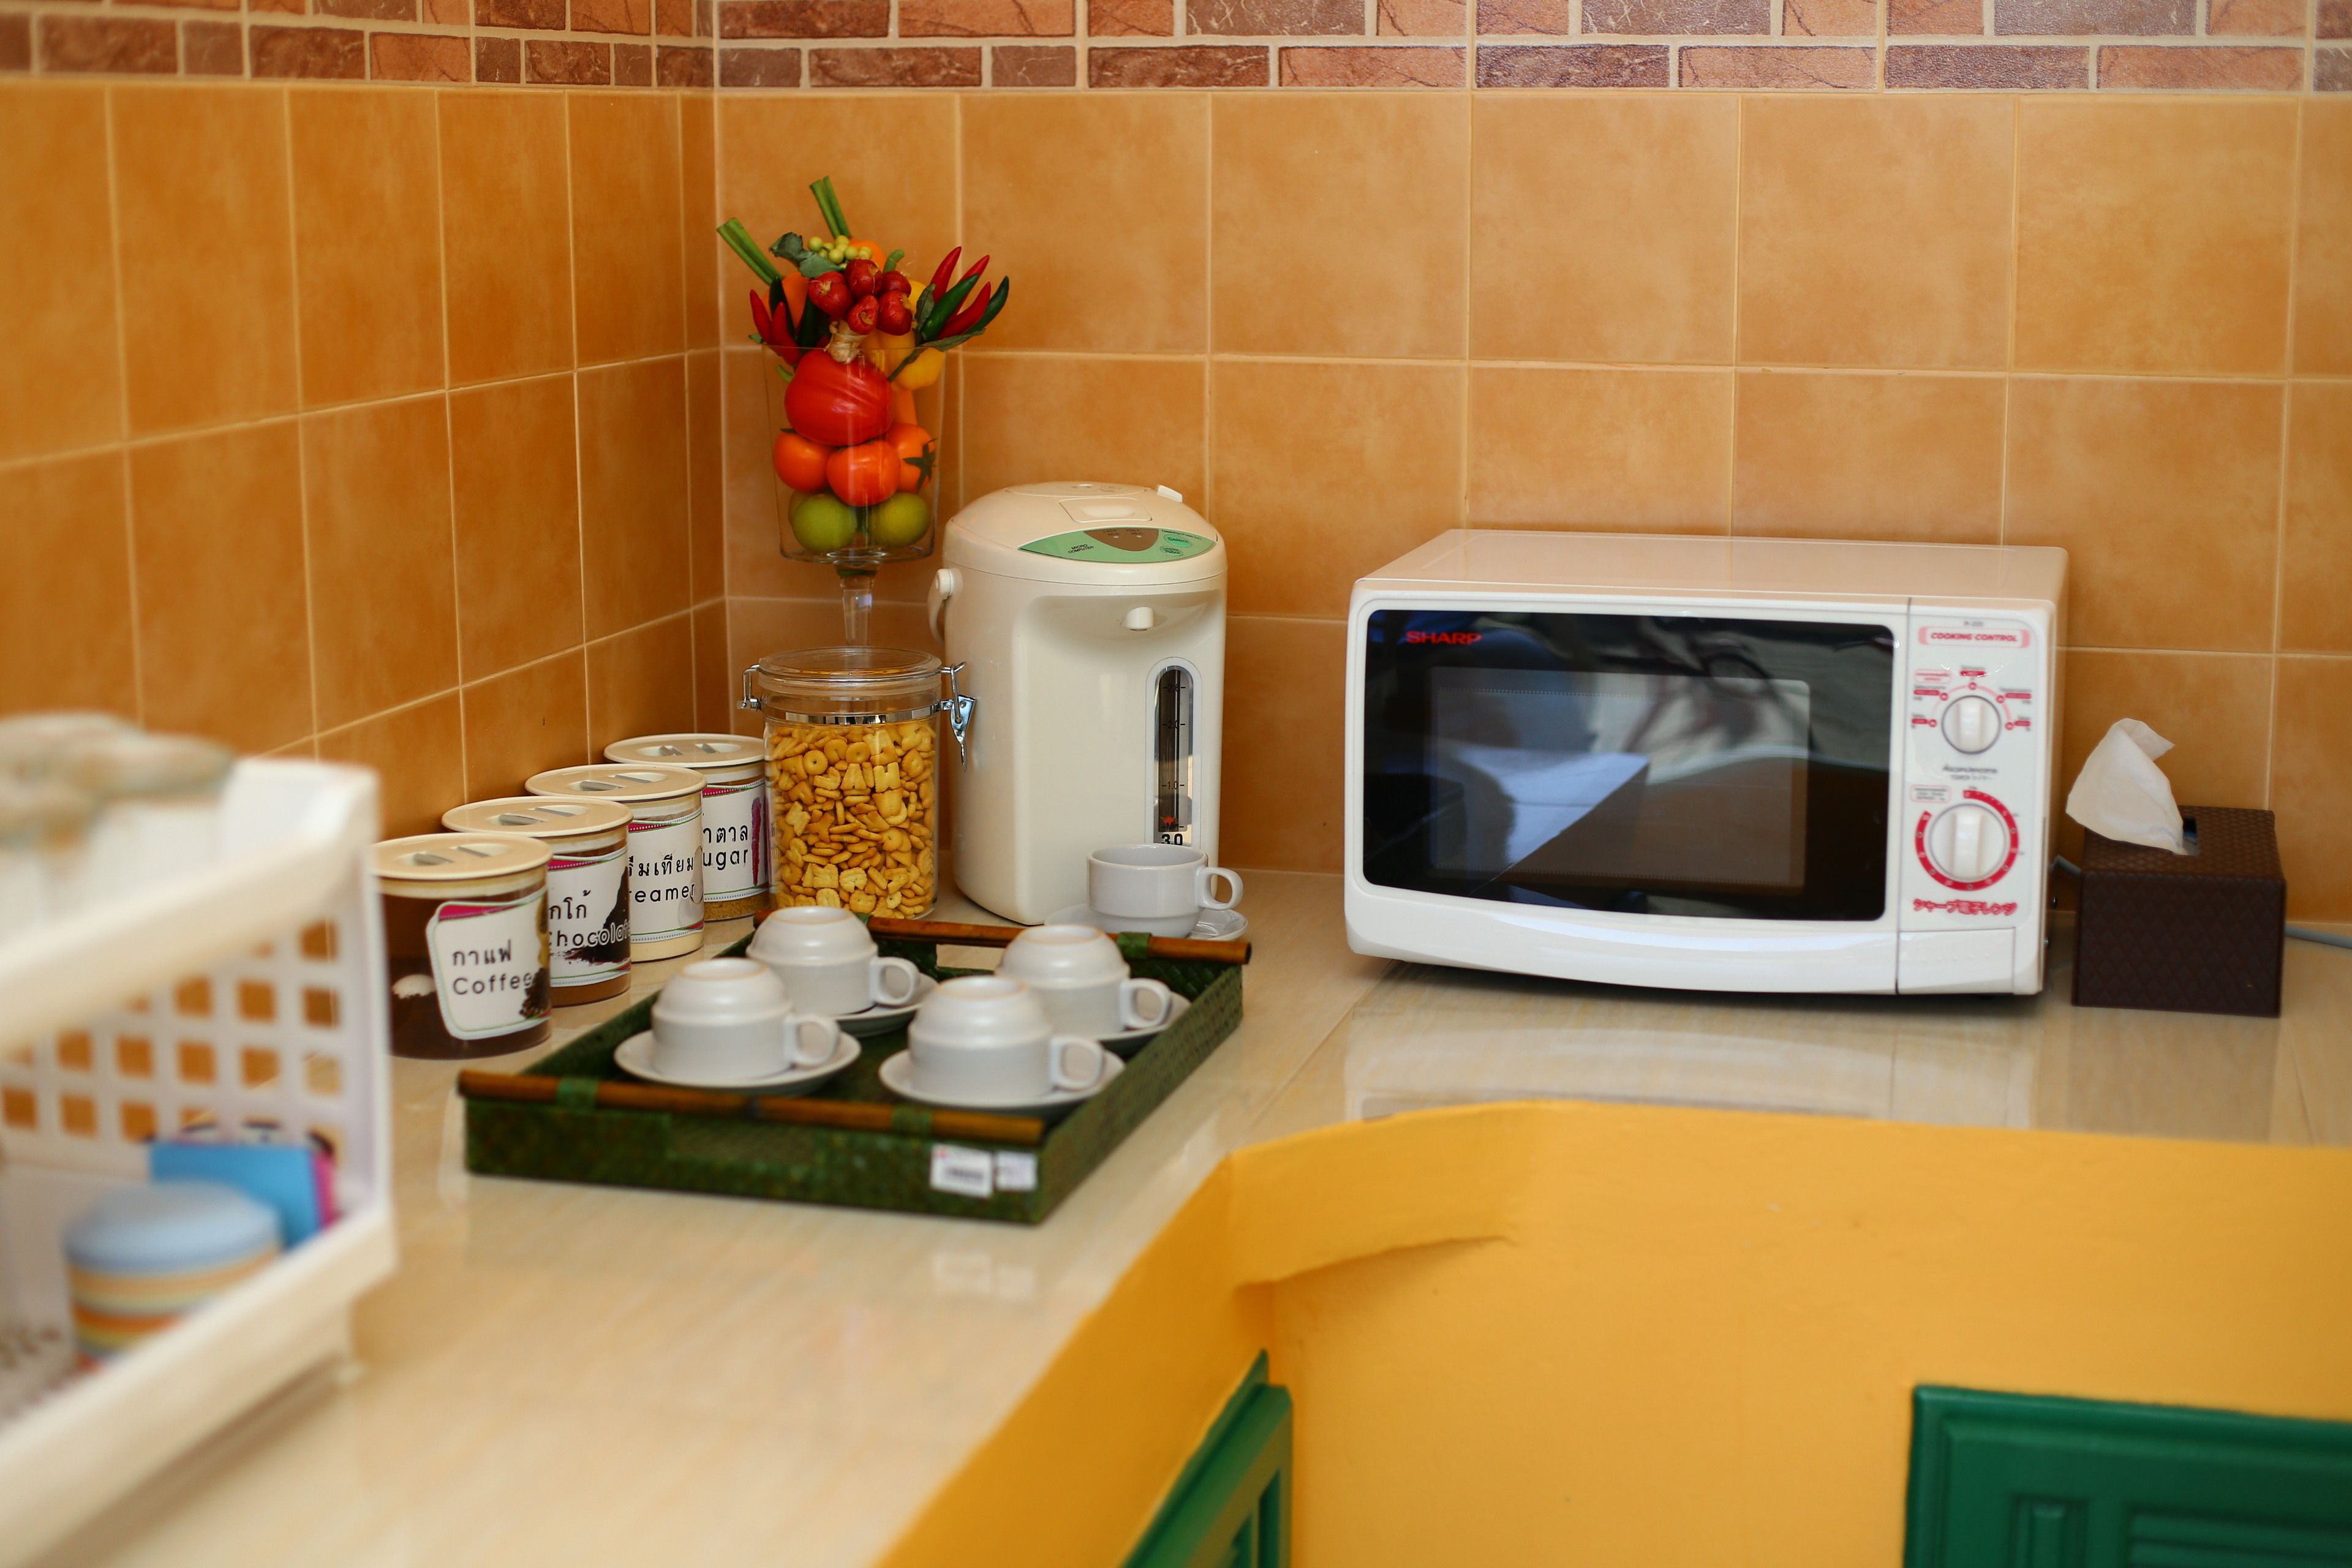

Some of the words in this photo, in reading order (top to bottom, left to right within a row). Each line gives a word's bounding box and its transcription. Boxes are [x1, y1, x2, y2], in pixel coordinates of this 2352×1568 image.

[1406, 631, 1483, 645] SHARP
[1931, 632, 1972, 641] COOKING
[1167, 781, 1178, 790] 1.0
[1161, 833, 1183, 846] 3.0
[703, 849, 748, 870] ugar
[629, 884, 695, 903] eamer
[549, 919, 629, 947] hocolat
[452, 938, 511, 966] กาแฟ
[453, 973, 532, 995] Coffee
